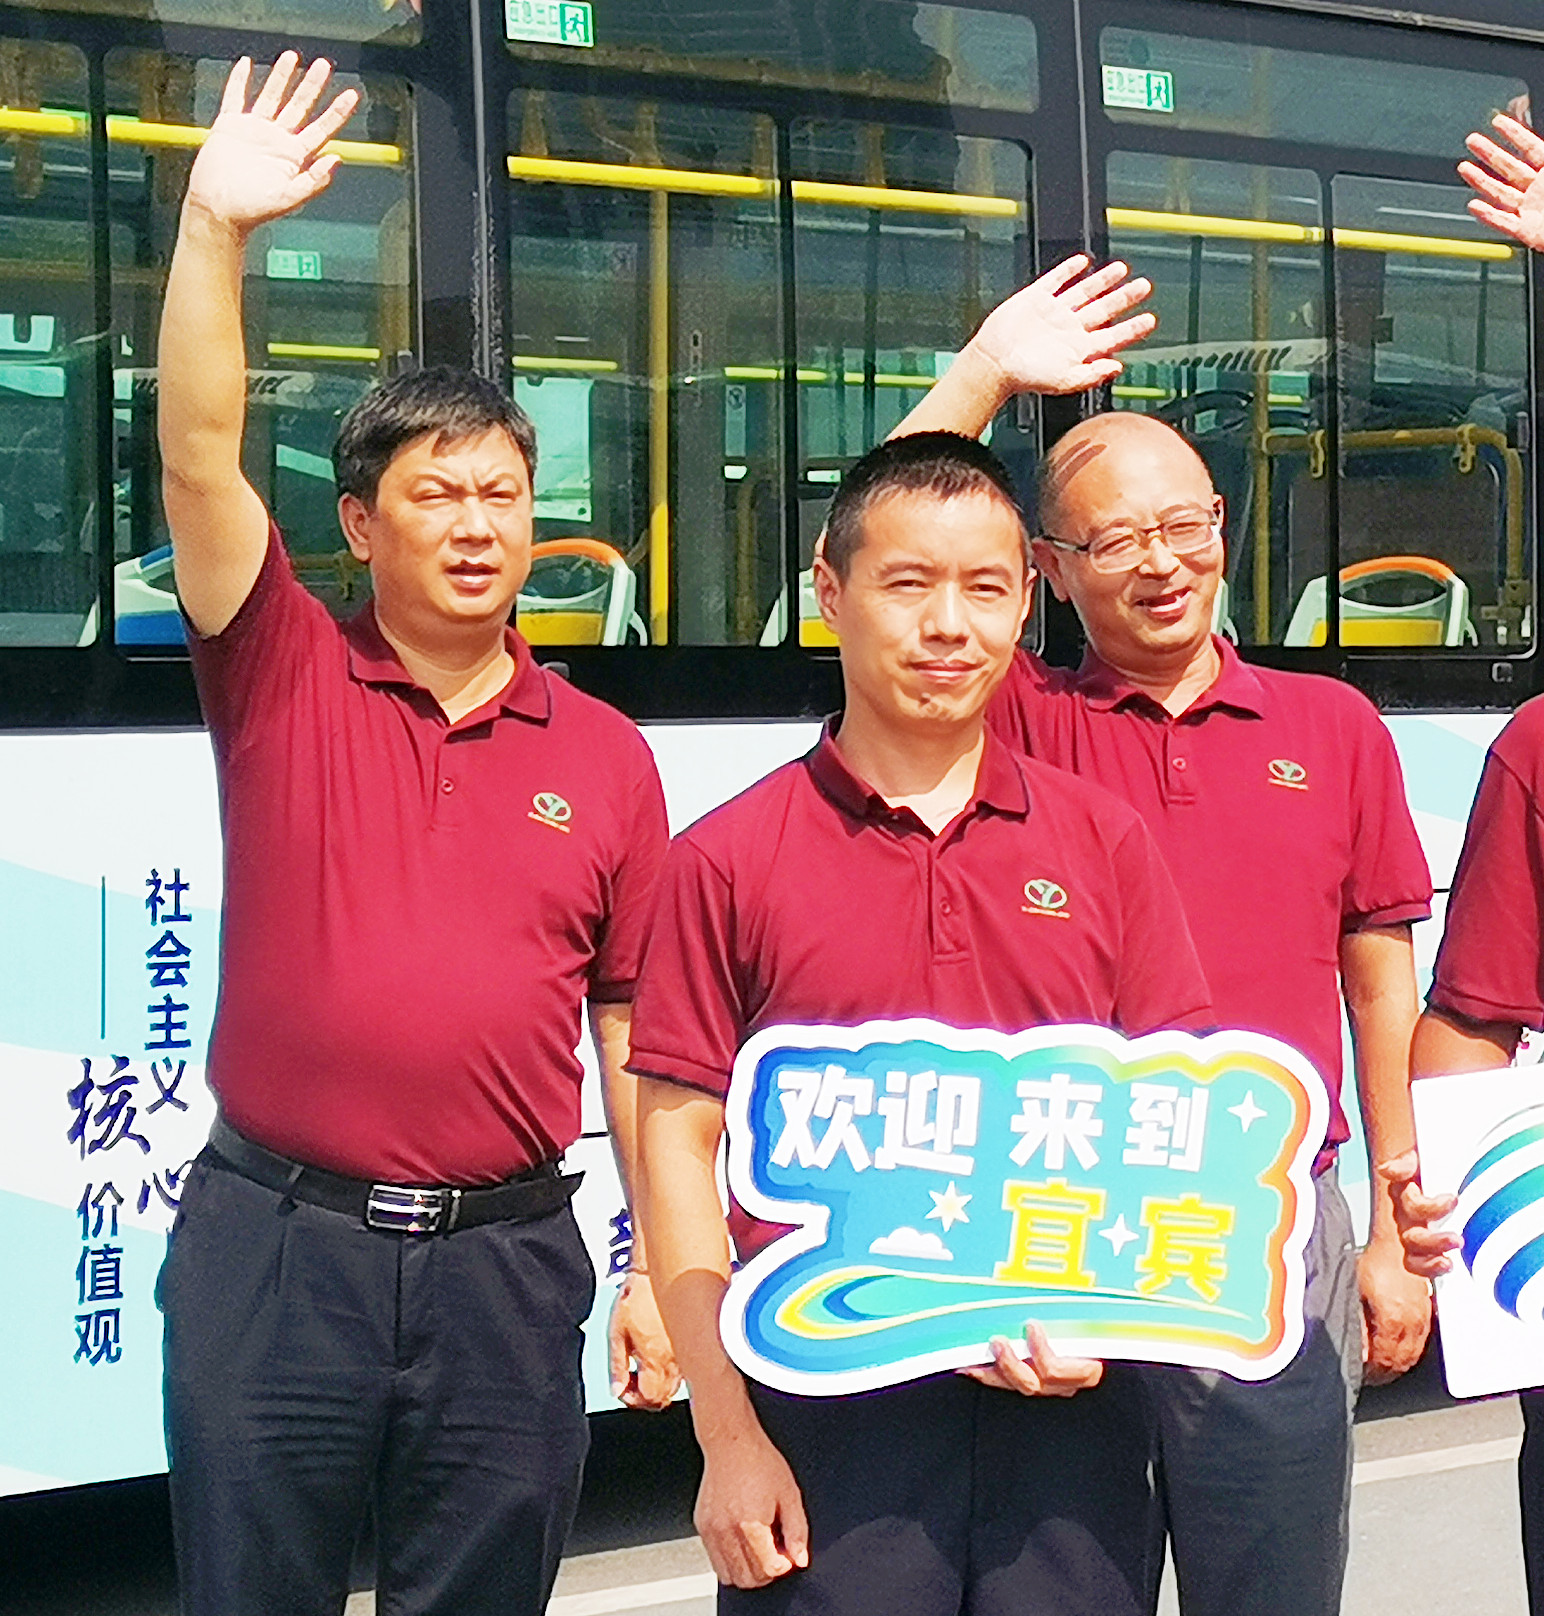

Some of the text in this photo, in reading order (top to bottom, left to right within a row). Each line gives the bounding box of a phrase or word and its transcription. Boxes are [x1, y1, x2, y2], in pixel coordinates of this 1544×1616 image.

[144, 868, 194, 1113] 社会主义
[73, 1181, 126, 1368] 价值观
[994, 1176, 1238, 1305] 宜宾
